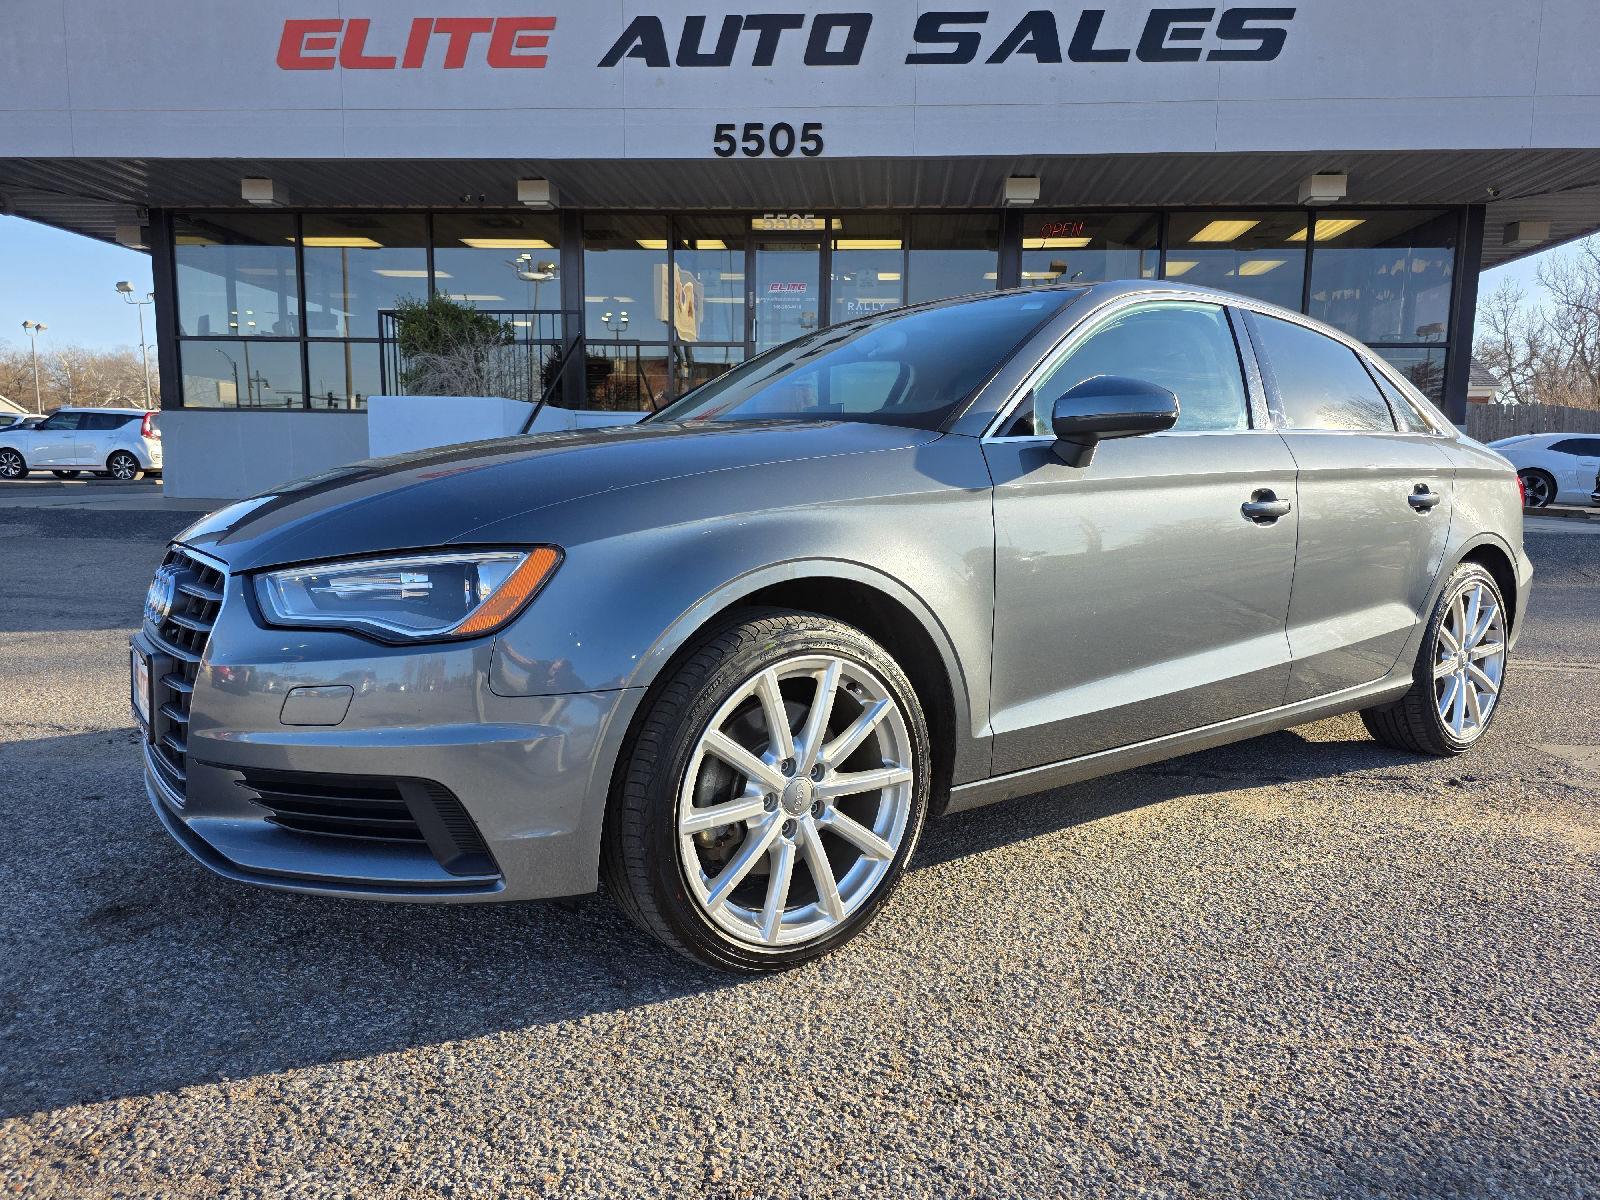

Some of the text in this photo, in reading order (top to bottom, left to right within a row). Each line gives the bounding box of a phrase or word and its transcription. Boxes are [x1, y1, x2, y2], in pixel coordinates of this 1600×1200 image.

[276, 7, 1296, 70] ELITE AUTO SALES
[713, 122, 824, 157] 5505
[763, 213, 815, 231] 5505
[1041, 221, 1084, 238] OPEN
[769, 282, 807, 291] ELITE
[847, 301, 885, 311] RALLY
